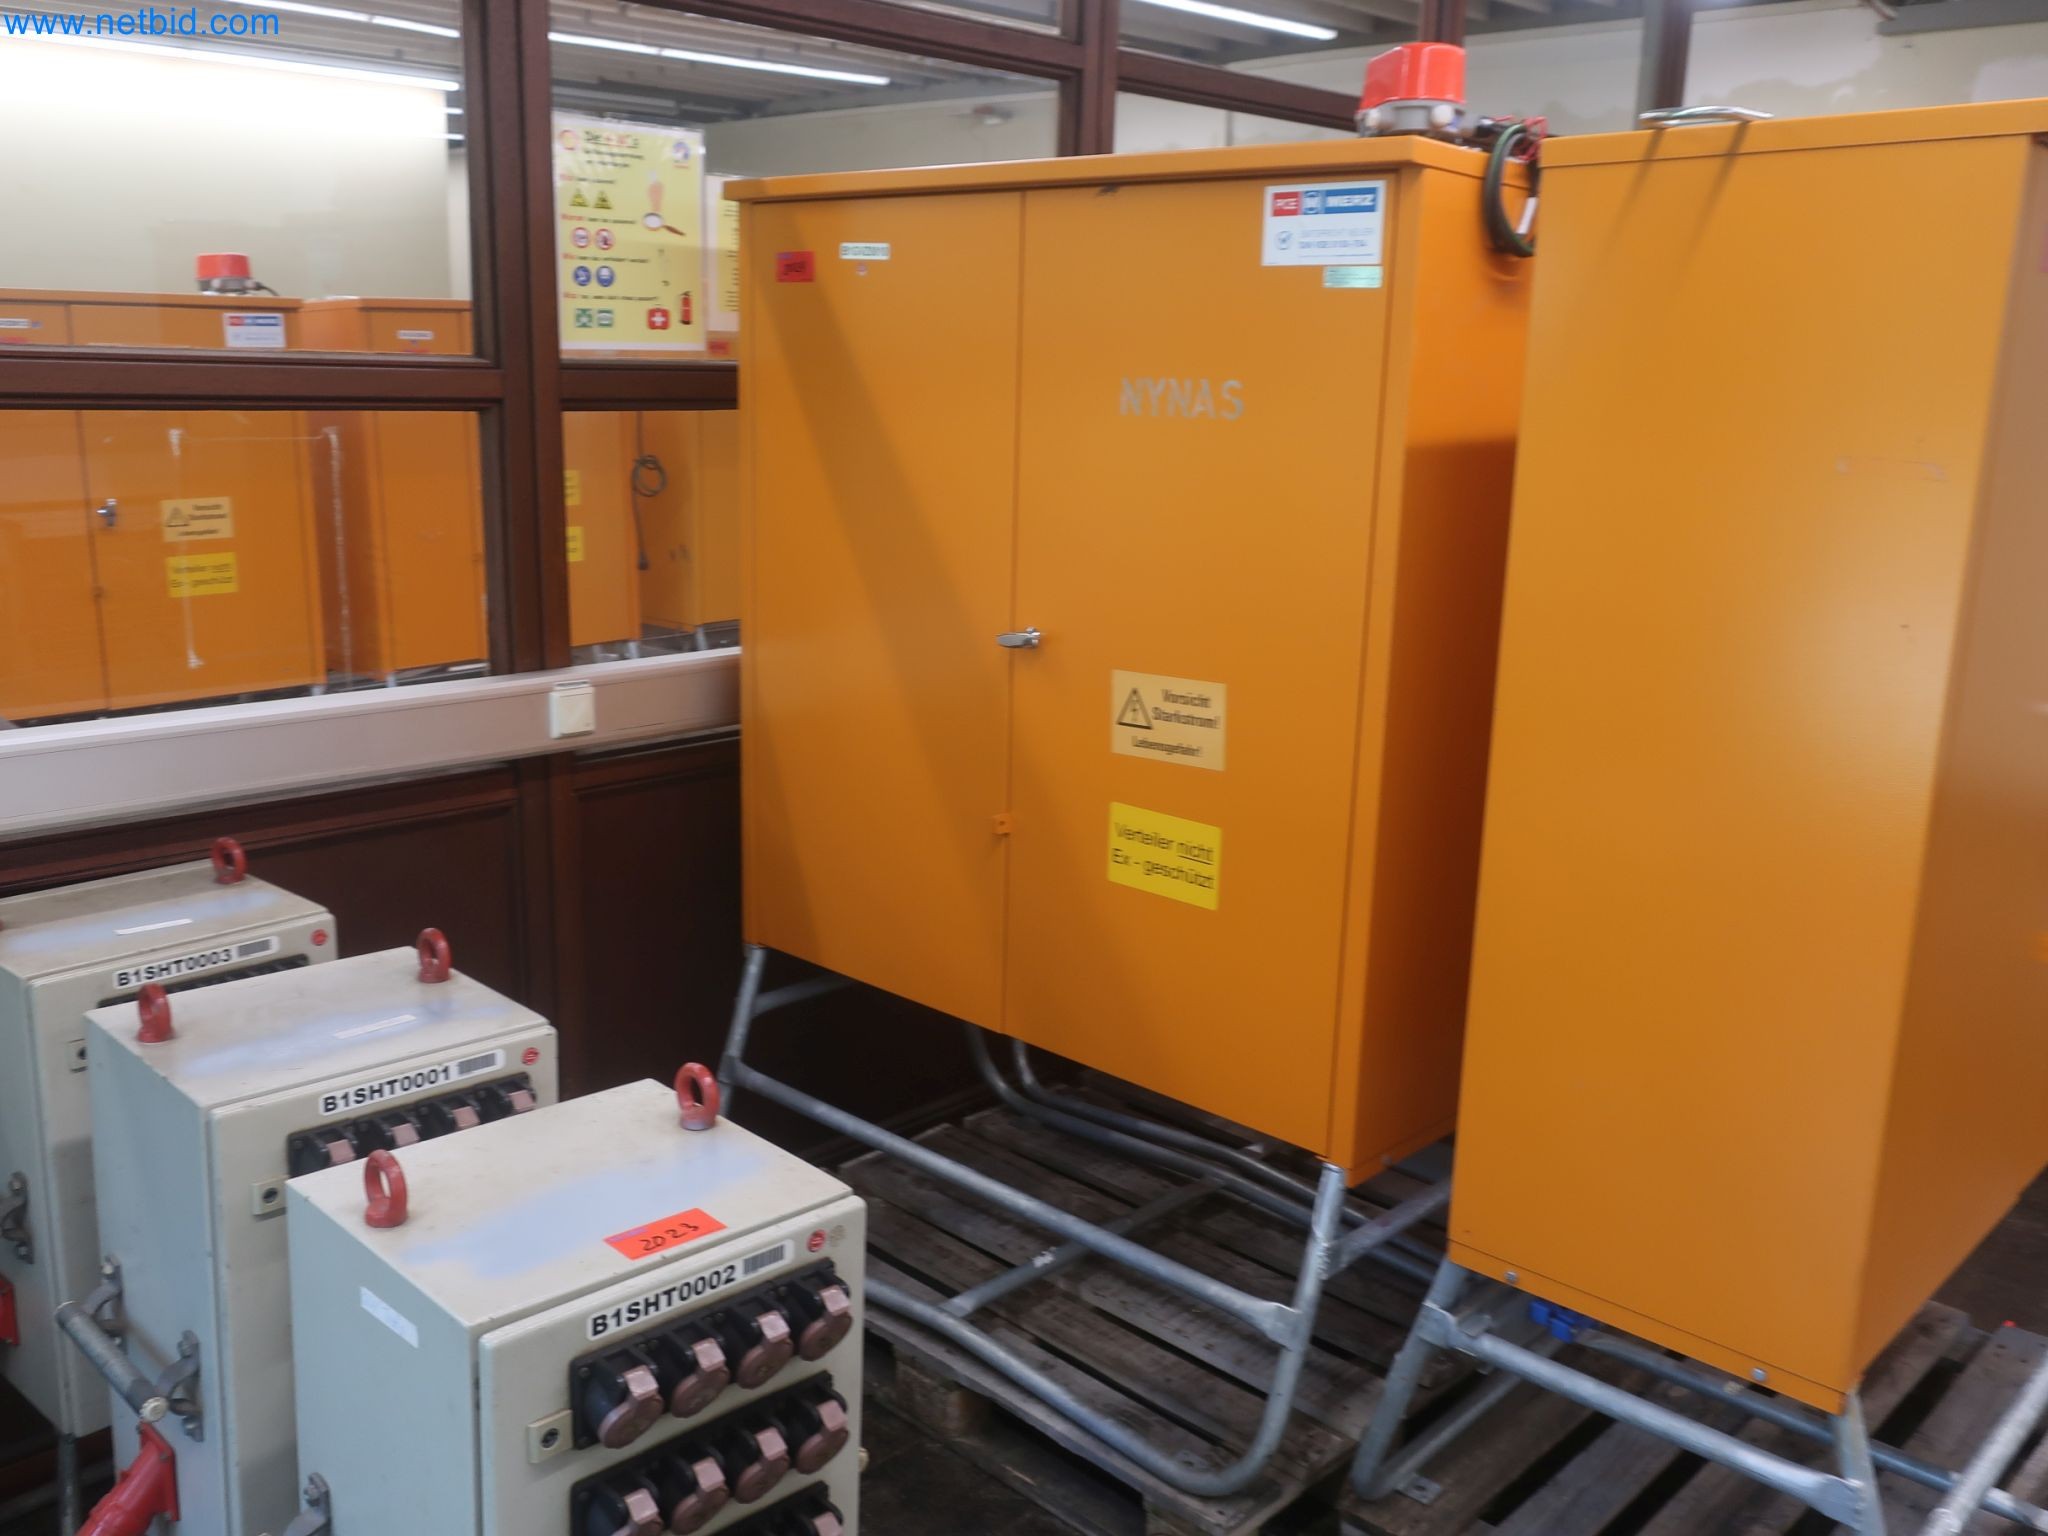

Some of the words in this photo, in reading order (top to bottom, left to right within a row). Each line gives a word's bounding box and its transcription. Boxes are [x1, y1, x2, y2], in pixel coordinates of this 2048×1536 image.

[1326, 193, 1376, 208] MERZ
[1119, 377, 1245, 421] NYNAS
[1114, 822, 1175, 851] Verteiler
[1176, 840, 1215, 863] nicht
[1111, 847, 1130, 866] Ex
[1143, 859, 1215, 890] geschützt
[117, 948, 232, 987] B1SHT0003
[323, 1065, 450, 1114] B1SHT0001
[640, 1222, 699, 1251] 2023
[591, 1264, 736, 1337] B1SHT0002
